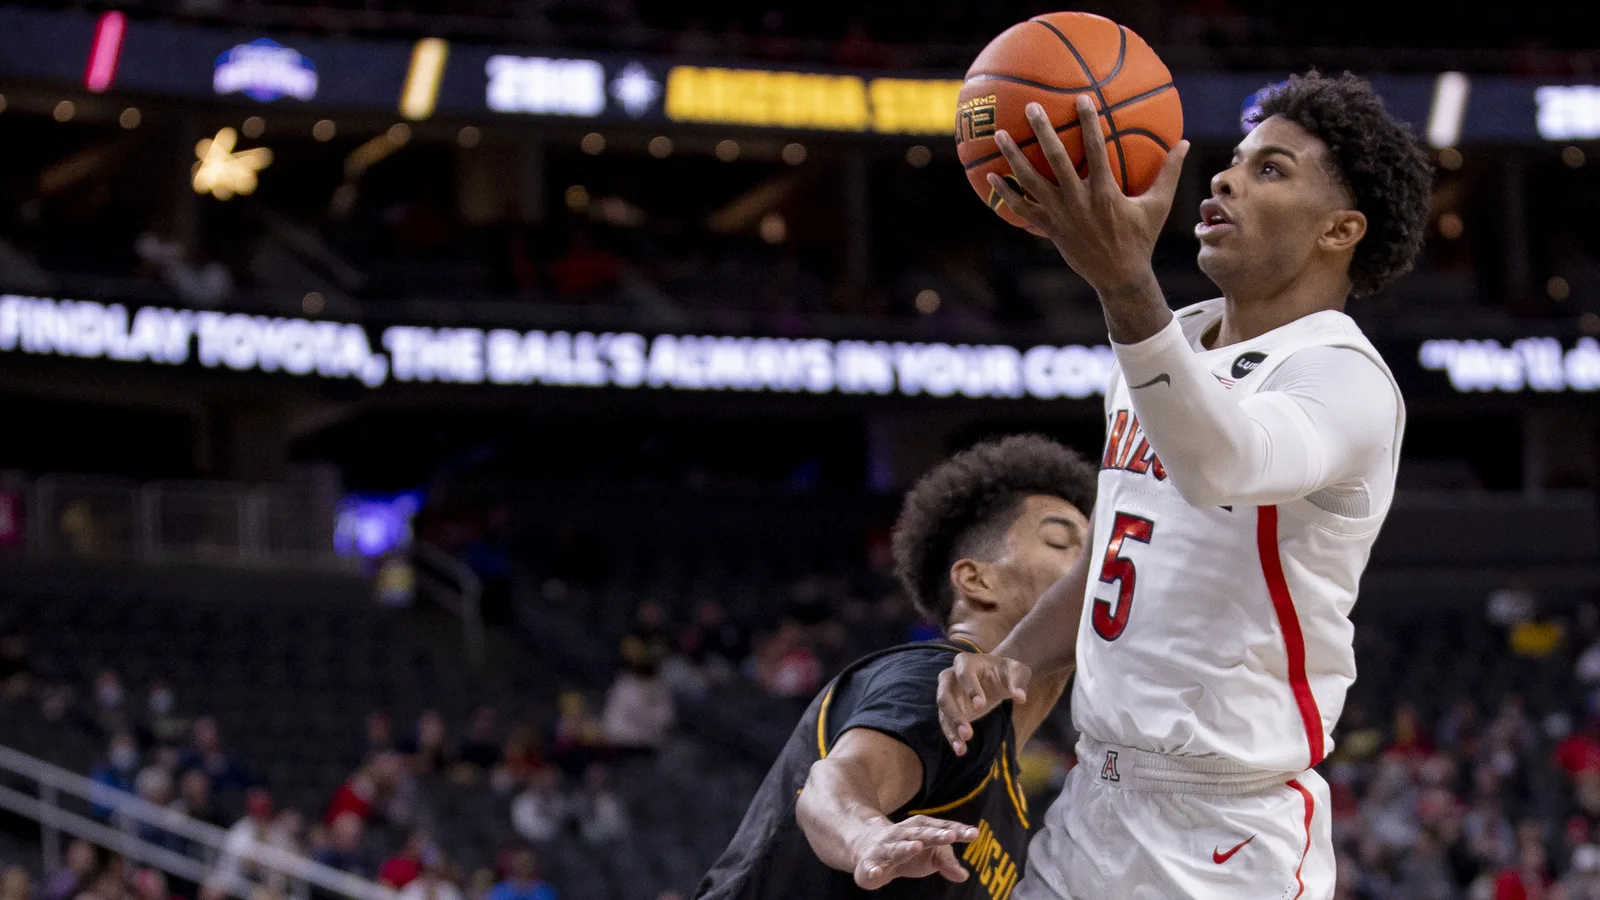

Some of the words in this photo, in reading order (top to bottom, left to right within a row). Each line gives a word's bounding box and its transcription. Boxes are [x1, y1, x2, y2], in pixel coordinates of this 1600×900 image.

[0, 294, 190, 365] FINDLAY
[196, 311, 388, 387] TOYOTA,
[382, 326, 484, 383] THE
[485, 329, 648, 388] BALL'S
[650, 334, 833, 394] ALWAYS
[835, 339, 893, 396] IN
[890, 341, 1025, 398] YOUR
[1092, 510, 1154, 642] 5
[1101, 750, 1120, 782] A
